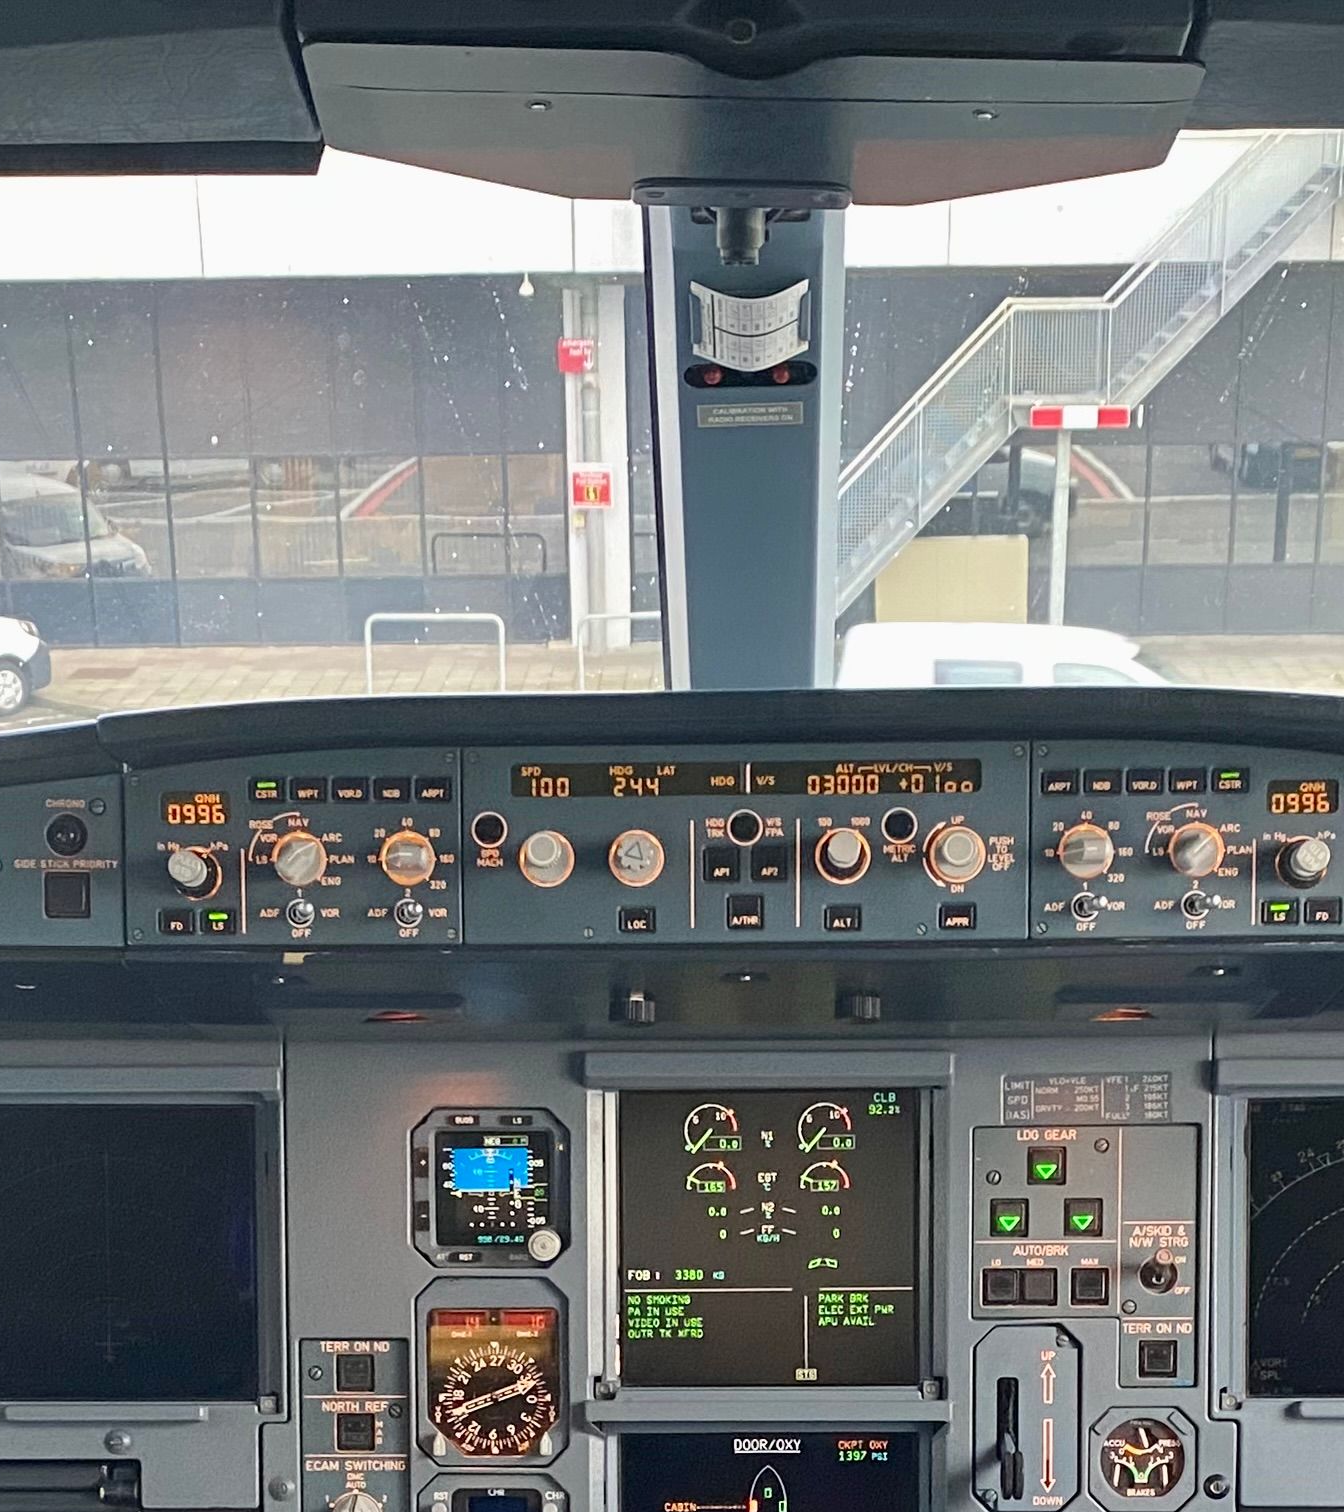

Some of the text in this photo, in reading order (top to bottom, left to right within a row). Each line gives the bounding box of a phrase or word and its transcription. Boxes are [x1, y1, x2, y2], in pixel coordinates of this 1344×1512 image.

[521, 766, 541, 776] SPD
[609, 766, 633, 776] HDG
[656, 765, 676, 776] LAT
[835, 764, 854, 773] ALT
[531, 777, 570, 797] 100
[613, 777, 659, 797] 244
[807, 775, 879, 795] 03000
[1300, 783, 1326, 792] QNH
[255, 790, 277, 799] CSTR
[1271, 793, 1330, 812] 0996
[167, 804, 226, 824] 0996
[1146, 812, 1171, 821] ROSE
[288, 818, 309, 827] NAV
[951, 816, 964, 824] UP
[321, 833, 342, 843] ARC
[989, 837, 1014, 845] PUSH
[329, 855, 354, 864] PLAN
[987, 854, 1015, 863] LEVEL
[1107, 873, 1124, 882] 320
[1218, 868, 1238, 877] ENG
[259, 909, 280, 918] ADF
[627, 920, 646, 929] LOC
[1076, 922, 1096, 931] OFF
[873, 1092, 896, 1102] CLB
[1016, 1130, 1077, 1140] LDG GEAR
[1132, 1226, 1172, 1236] A/SKID
[1129, 1237, 1189, 1248] N/W STRG
[1013, 1245, 1069, 1256] AUTO/BRK
[628, 1270, 704, 1280] FOB 3380
[628, 1295, 691, 1305] NO SMOKING
[818, 1294, 869, 1303] PARK BRK
[628, 1307, 684, 1316] PA IN USE
[818, 1305, 844, 1314] ELEC
[850, 1304, 869, 1314] EXT
[628, 1318, 704, 1328] VIDEO IN USE
[818, 1316, 874, 1326] APU AVAIL
[628, 1329, 654, 1338] OUTR
[660, 1329, 672, 1338] TK
[1123, 1323, 1192, 1334] TERR ON ND
[320, 1341, 390, 1352] TERR ON ND
[1041, 1350, 1056, 1361] UP
[322, 1401, 388, 1411] NORTH REF
[734, 1439, 801, 1451] DOOR/OXY
[838, 1440, 888, 1450] CKPT OXY
[838, 1451, 888, 1462] 1397 PSI
[306, 1461, 406, 1471] ECAM SWITCHING
[1032, 1496, 1063, 1505] DOWN
[664, 1502, 697, 1512] CABIN
